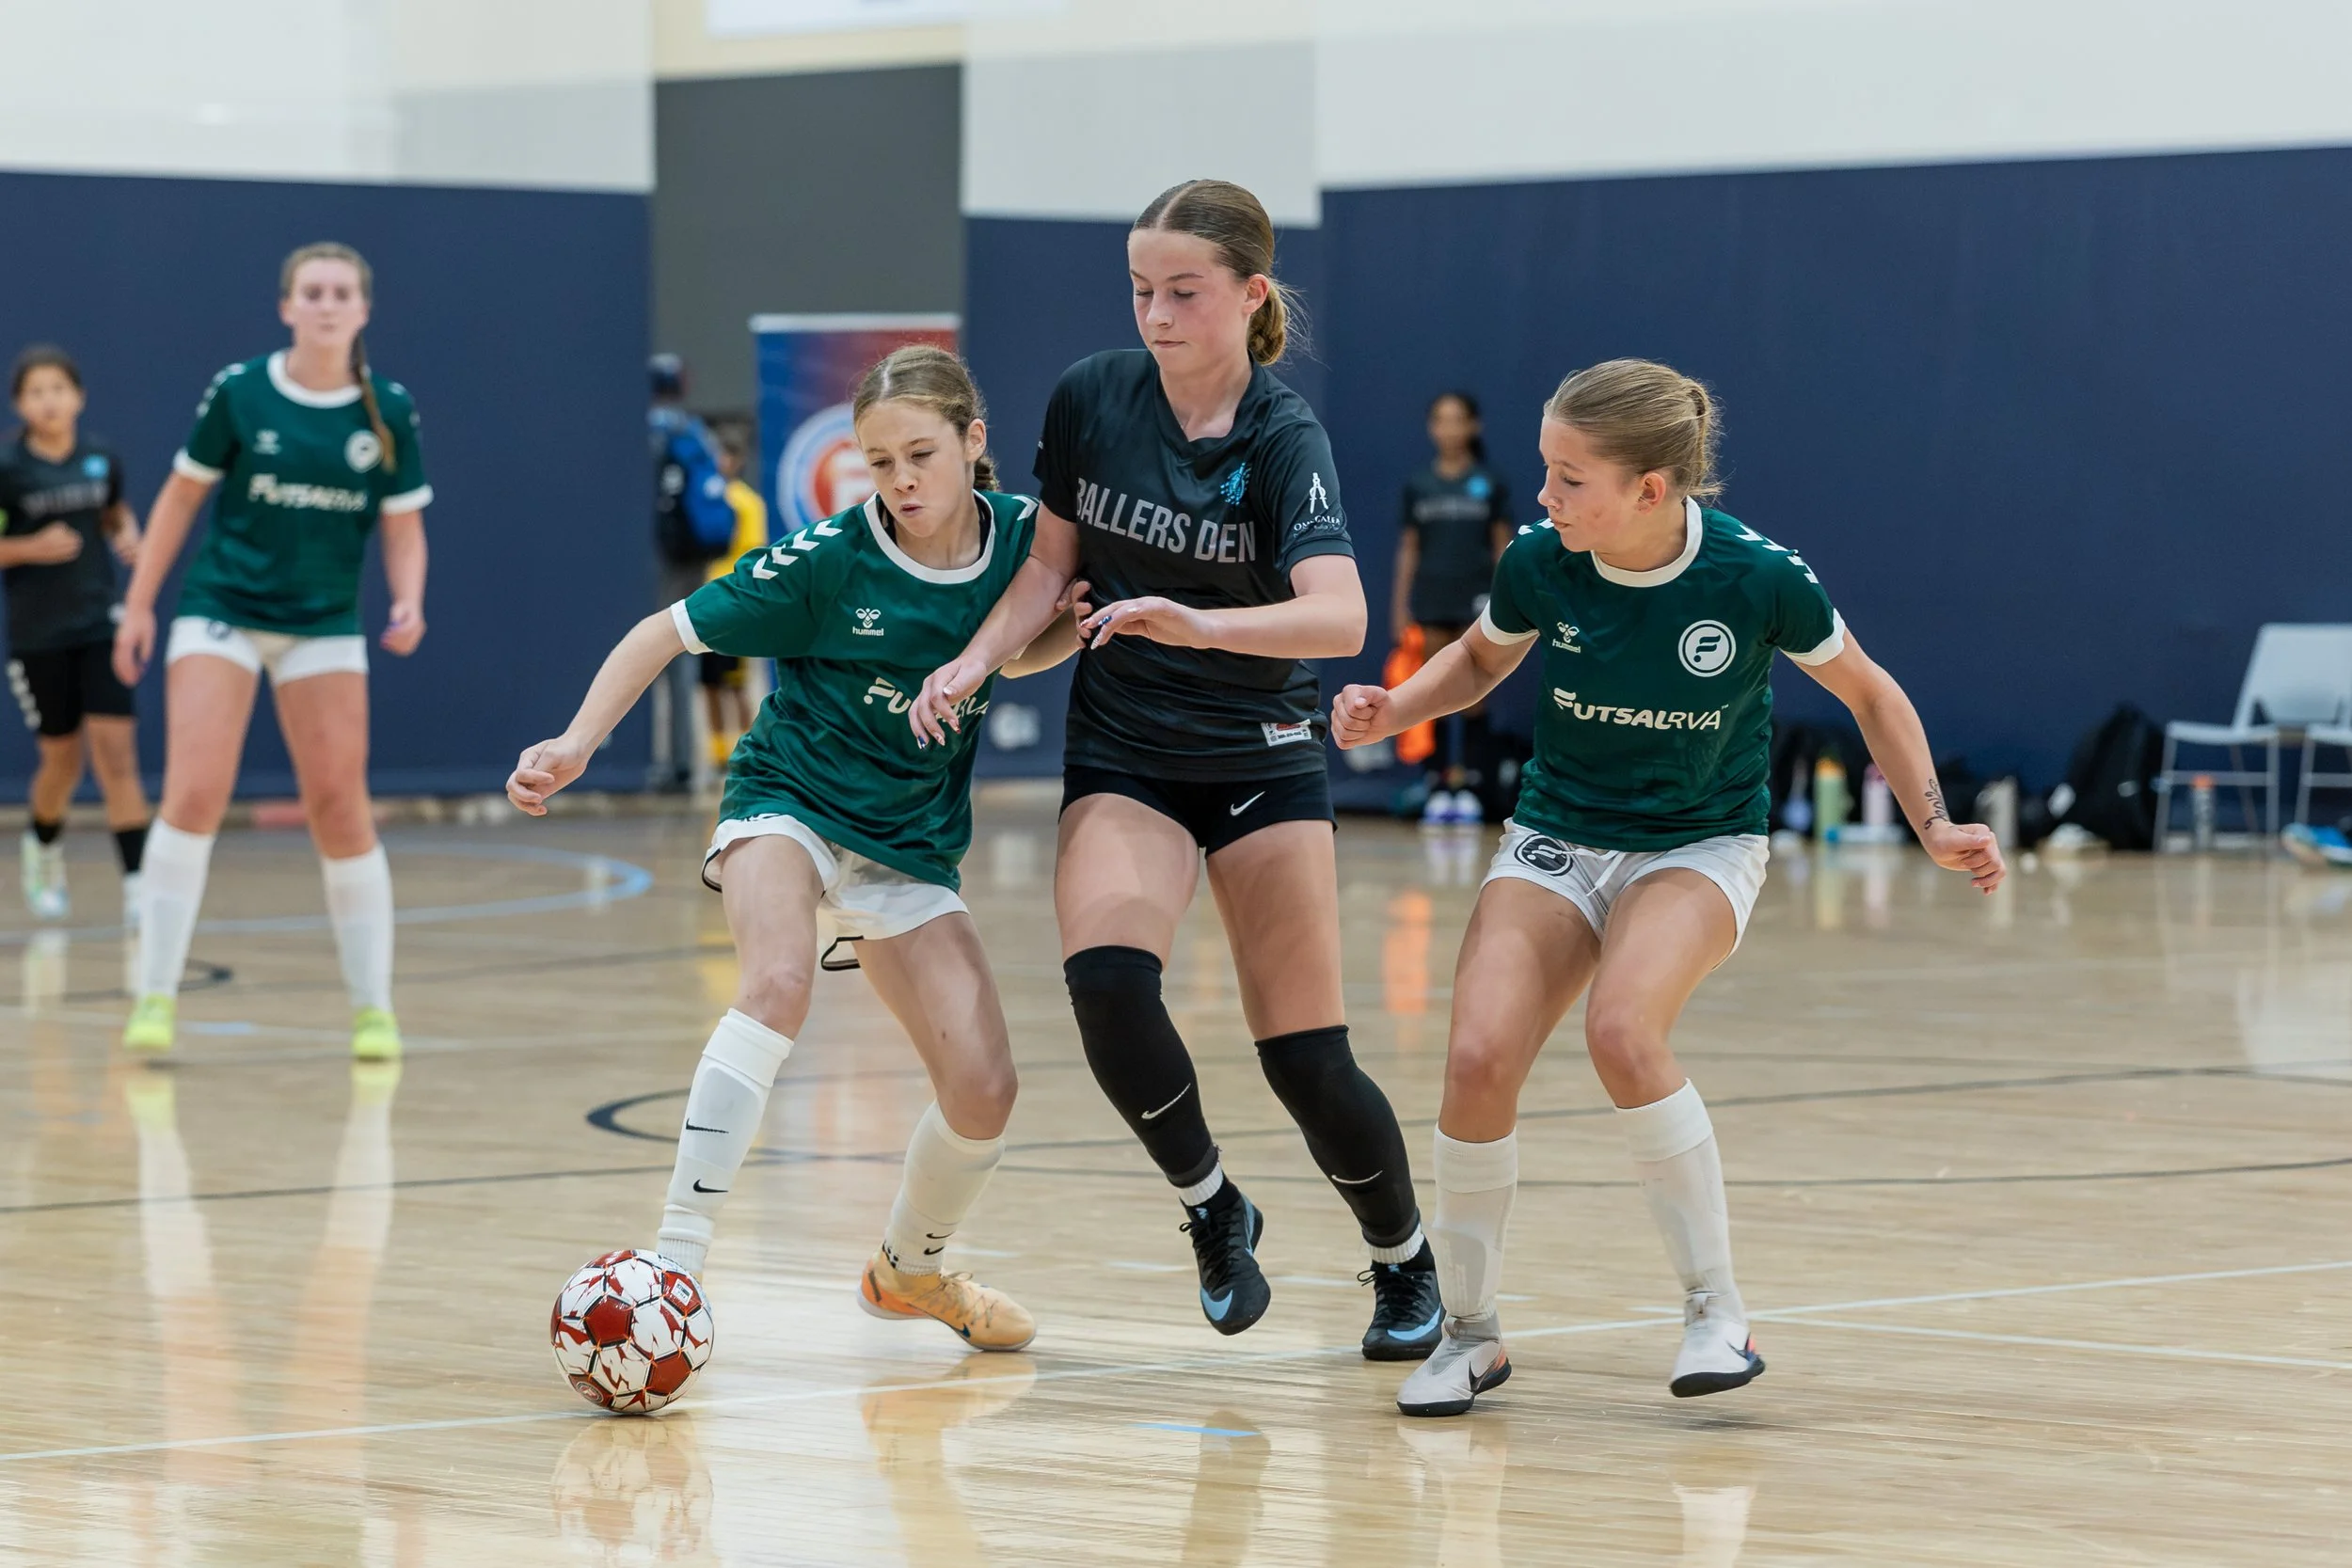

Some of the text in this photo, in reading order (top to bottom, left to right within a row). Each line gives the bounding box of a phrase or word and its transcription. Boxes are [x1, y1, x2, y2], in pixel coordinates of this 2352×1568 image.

[1194, 519, 1256, 563] DEN
[852, 626, 884, 637] hummel
[1551, 638, 1581, 654] hummel
